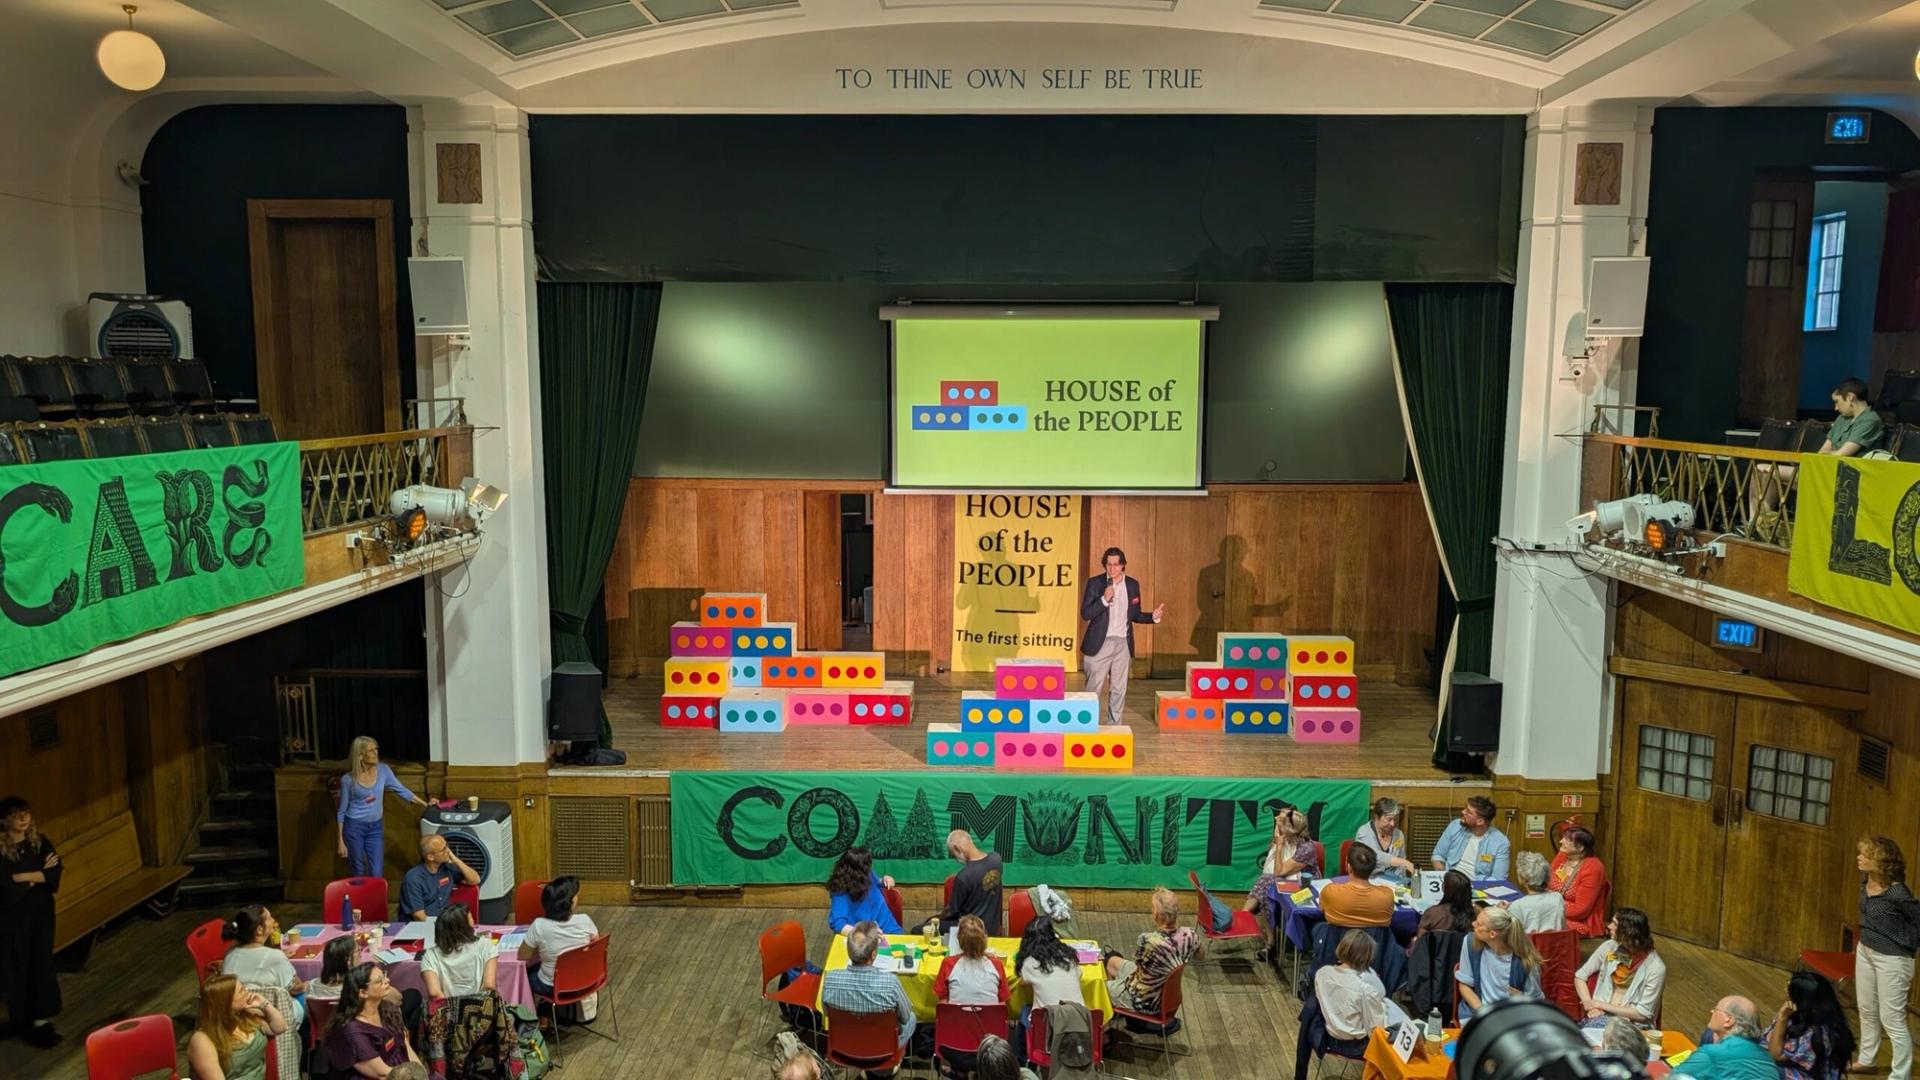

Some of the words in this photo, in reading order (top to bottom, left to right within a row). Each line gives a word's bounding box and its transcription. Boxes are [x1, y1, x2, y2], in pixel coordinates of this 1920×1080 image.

[836, 69, 872, 89] TO
[887, 69, 952, 89] THINE
[967, 69, 1026, 89] OWN
[1042, 69, 1092, 89] SELF
[1104, 69, 1131, 89] BE
[1142, 69, 1203, 89] TRUE
[1045, 380, 1141, 402] HOUSE
[1148, 380, 1176, 402] of
[1034, 411, 1070, 432] the
[1078, 411, 1182, 432] PEOPLE
[966, 495, 1071, 518] HOUSE
[1829, 460, 1920, 596] L
[0, 459, 271, 627] CARE
[978, 529, 1008, 552] of
[1013, 530, 1053, 553] the
[959, 561, 1072, 587] PEOPLE
[956, 630, 983, 643] The
[987, 631, 1018, 645] first
[1022, 634, 1073, 651] sitting
[1719, 622, 1755, 645] EXIT
[1429, 880, 1440, 893] 3
[1400, 1030, 1412, 1051] 13
